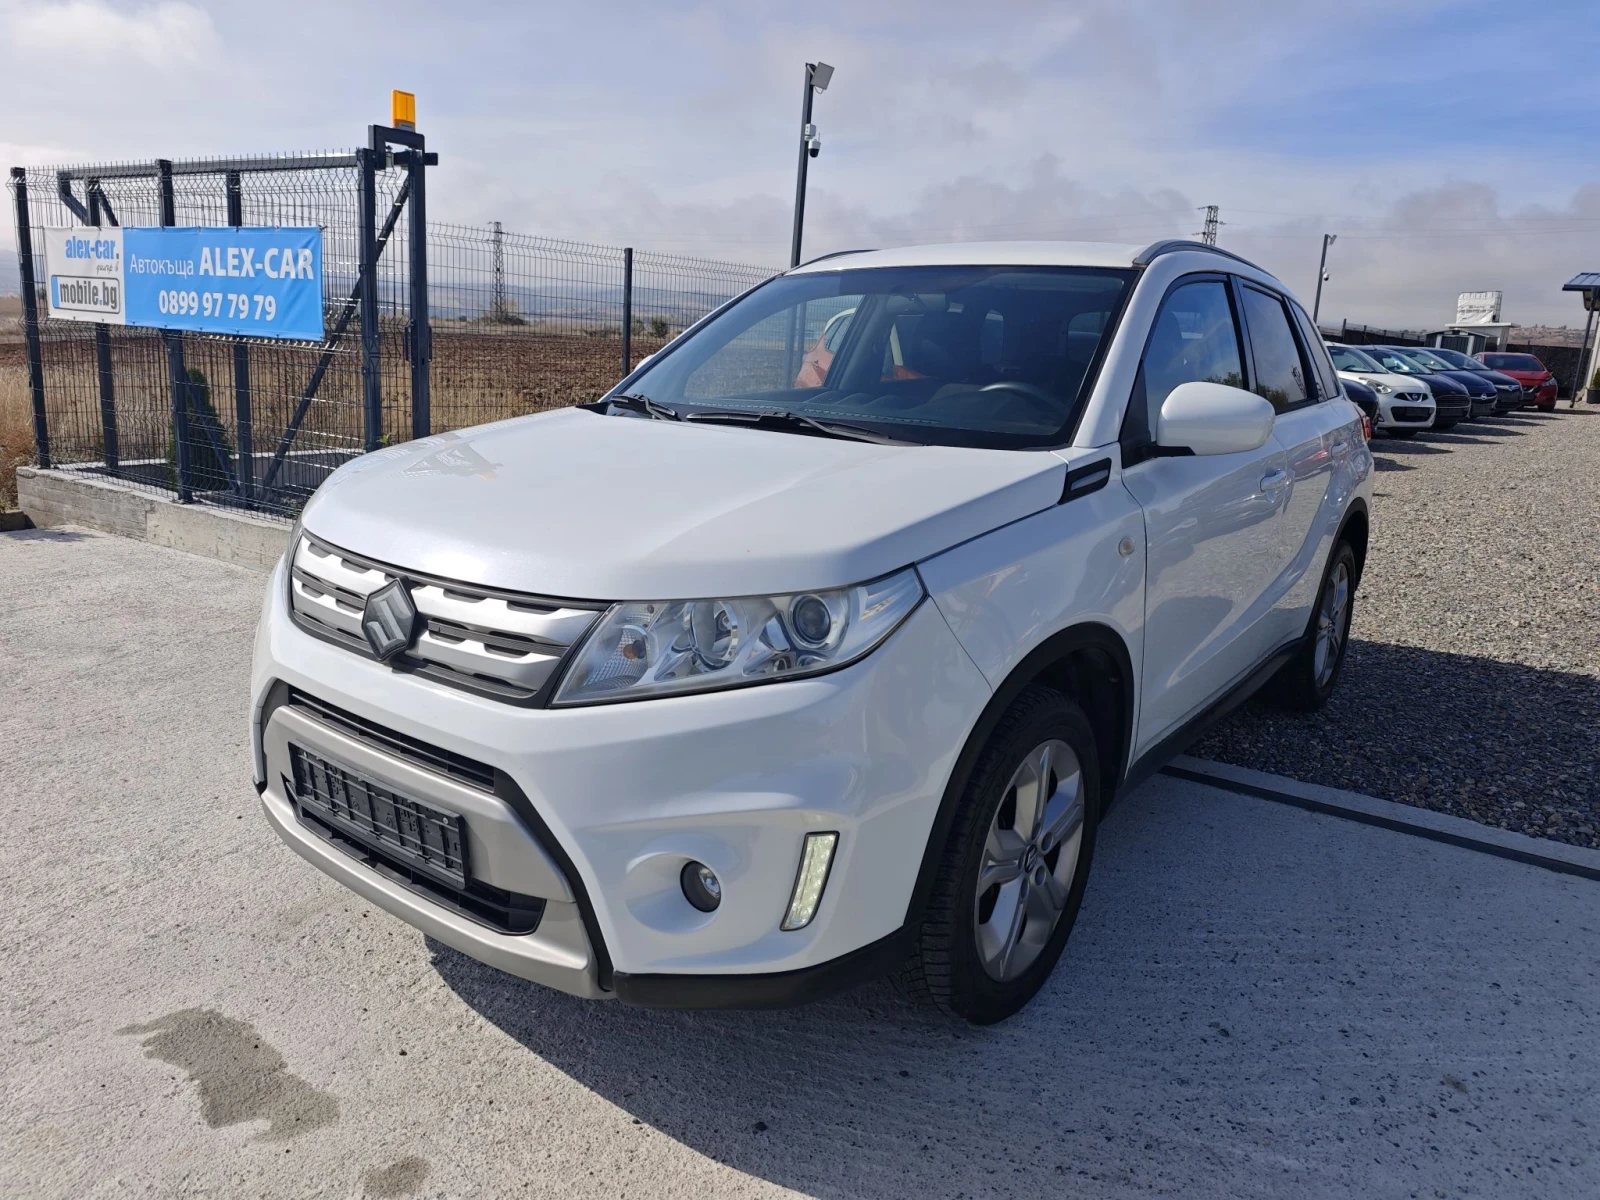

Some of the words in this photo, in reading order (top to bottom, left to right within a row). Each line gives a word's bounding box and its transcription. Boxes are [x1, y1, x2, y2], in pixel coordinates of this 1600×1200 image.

[65, 235, 120, 260] alex-car.
[129, 253, 194, 280] Автокъща
[198, 246, 314, 280] ALEX-CAR
[59, 280, 118, 310] mobile.bg
[158, 289, 199, 316] 0899
[202, 291, 223, 318] 97
[227, 293, 250, 320] 79
[253, 294, 277, 322] 79
